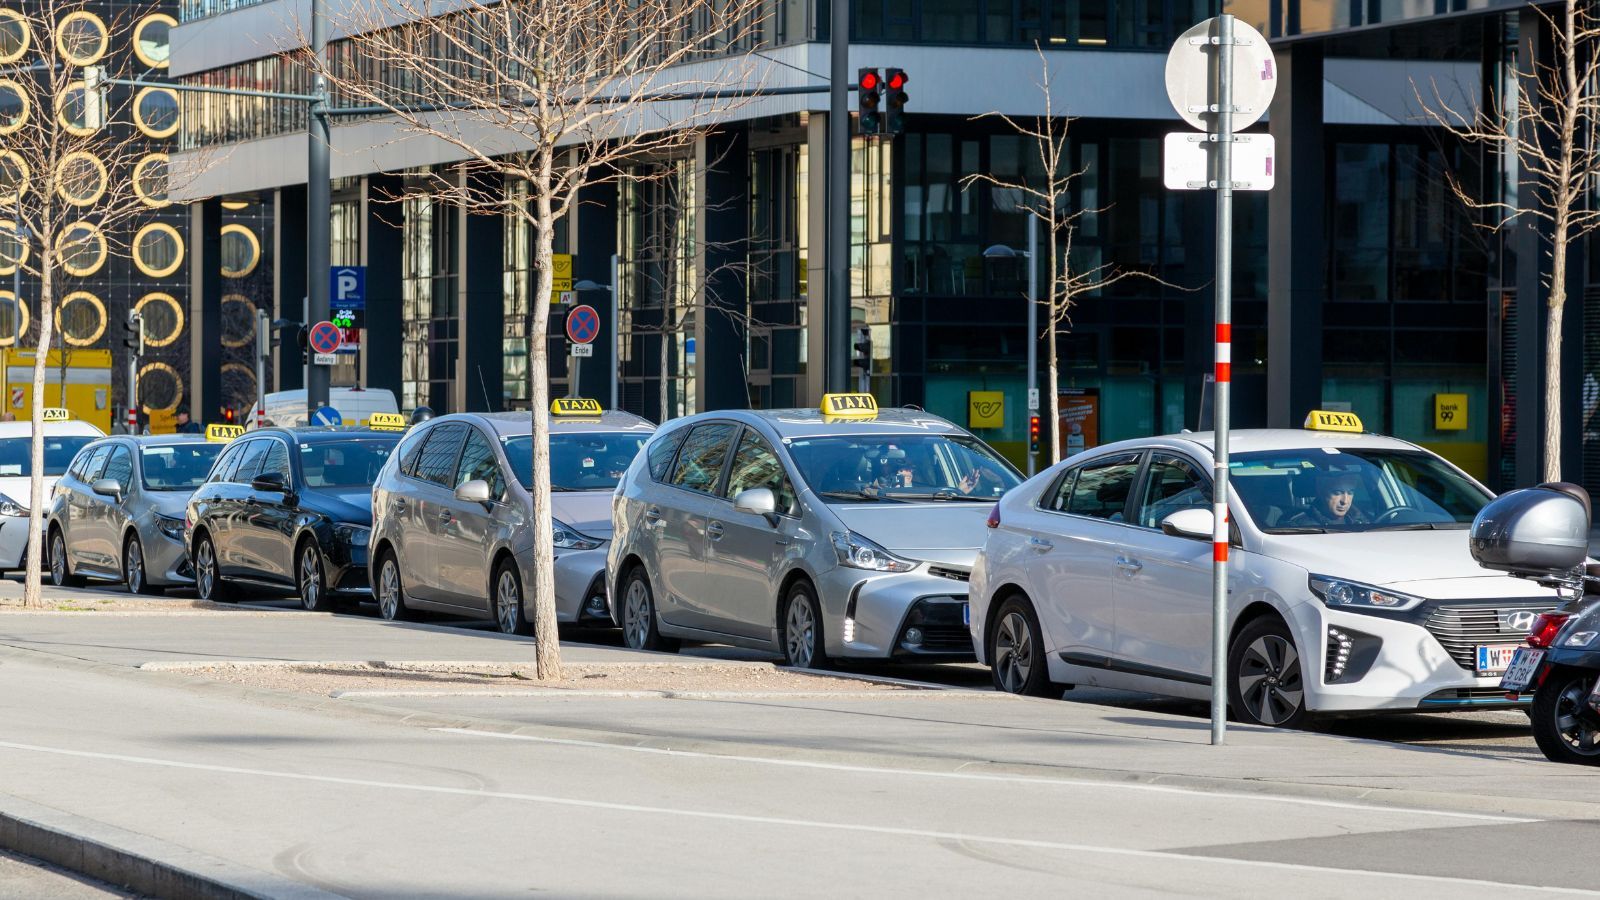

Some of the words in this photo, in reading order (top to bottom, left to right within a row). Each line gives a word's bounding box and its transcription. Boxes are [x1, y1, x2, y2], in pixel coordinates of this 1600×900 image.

[338, 275, 357, 300] P
[575, 346, 589, 354] Ende
[560, 400, 597, 410] TAXI
[833, 396, 873, 410] TAXI
[1440, 403, 1458, 411] bank
[43, 410, 66, 418] AXI
[374, 415, 401, 424] TAXI
[1440, 411, 1454, 422] 99
[1319, 413, 1357, 427] TAXI
[213, 426, 245, 438] TAXI
[1490, 649, 1501, 667] W
[1507, 666, 1517, 680] 5
